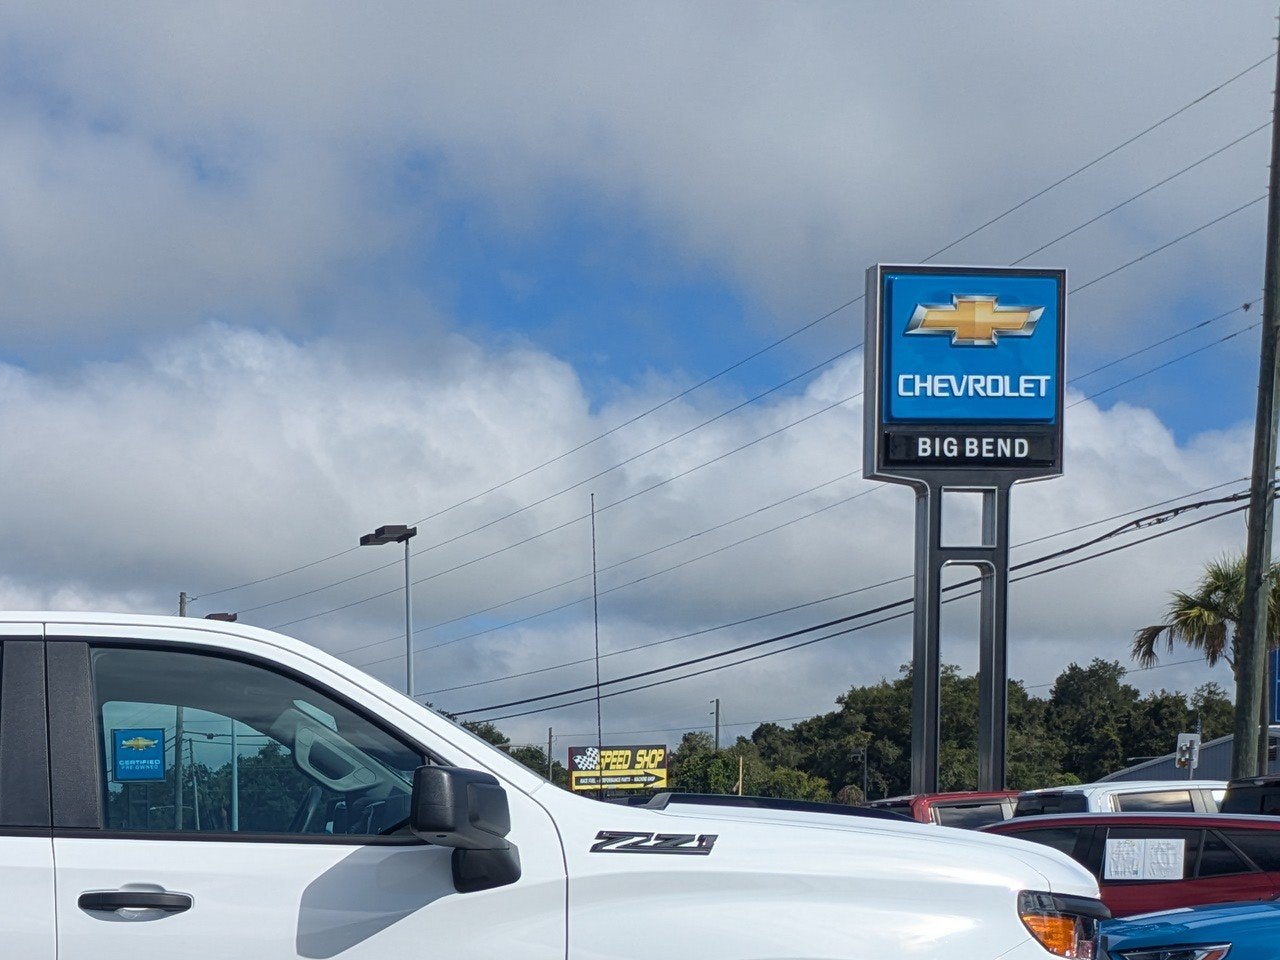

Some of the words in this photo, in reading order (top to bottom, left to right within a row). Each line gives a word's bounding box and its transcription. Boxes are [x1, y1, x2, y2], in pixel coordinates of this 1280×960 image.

[897, 374, 1051, 397] CHEVROLET
[918, 437, 958, 457] BIG
[965, 438, 1029, 458] BEND
[596, 750, 631, 770] SPEED
[635, 749, 665, 769] SHOP
